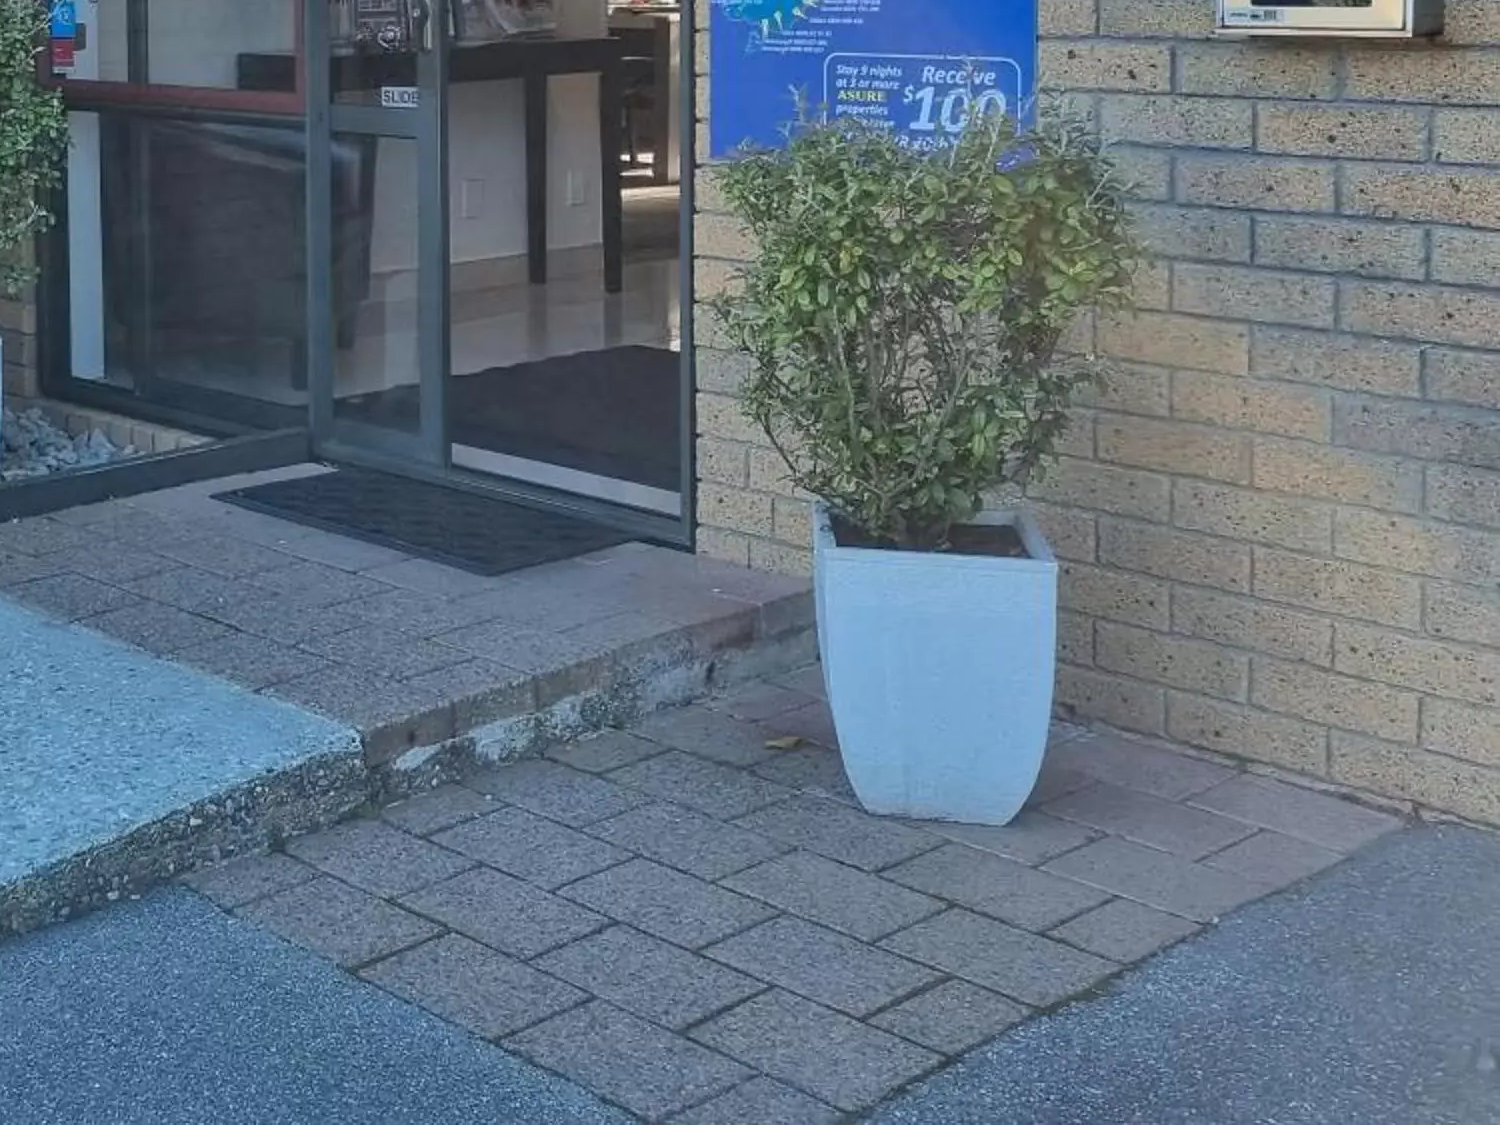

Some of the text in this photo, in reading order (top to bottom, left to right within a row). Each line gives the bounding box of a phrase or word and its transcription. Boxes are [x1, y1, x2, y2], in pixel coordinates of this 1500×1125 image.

[836, 64, 858, 79] Stay
[869, 64, 902, 79] nights
[921, 64, 997, 86] Receve
[836, 78, 847, 88] at
[858, 80, 870, 88] or
[871, 80, 901, 89] more
[383, 90, 421, 104] SLIDE
[837, 89, 887, 101] ASURE
[902, 83, 1007, 134] $100
